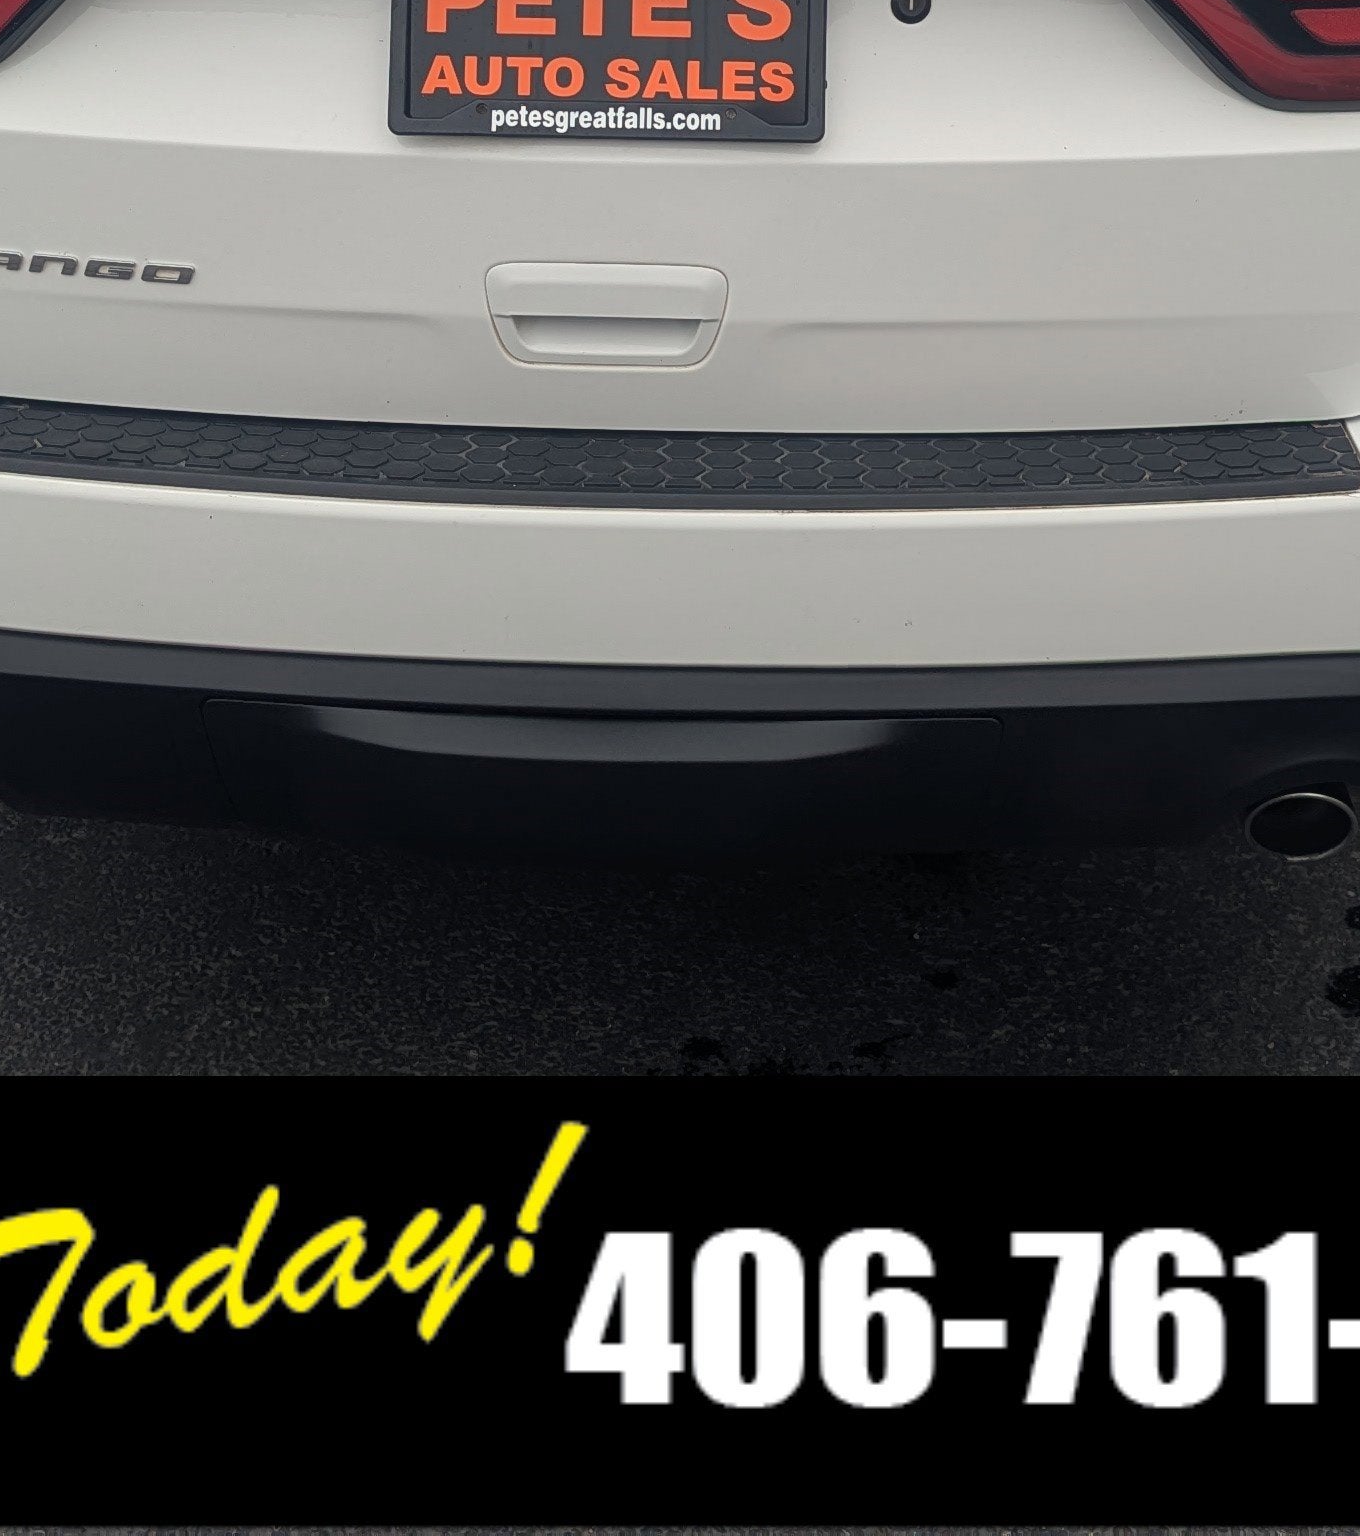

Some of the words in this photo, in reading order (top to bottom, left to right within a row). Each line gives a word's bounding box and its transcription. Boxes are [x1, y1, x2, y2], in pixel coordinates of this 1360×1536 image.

[421, 55, 585, 98] AUTO
[604, 59, 796, 103] SALES
[490, 106, 722, 135] petesgreatfalls.com
